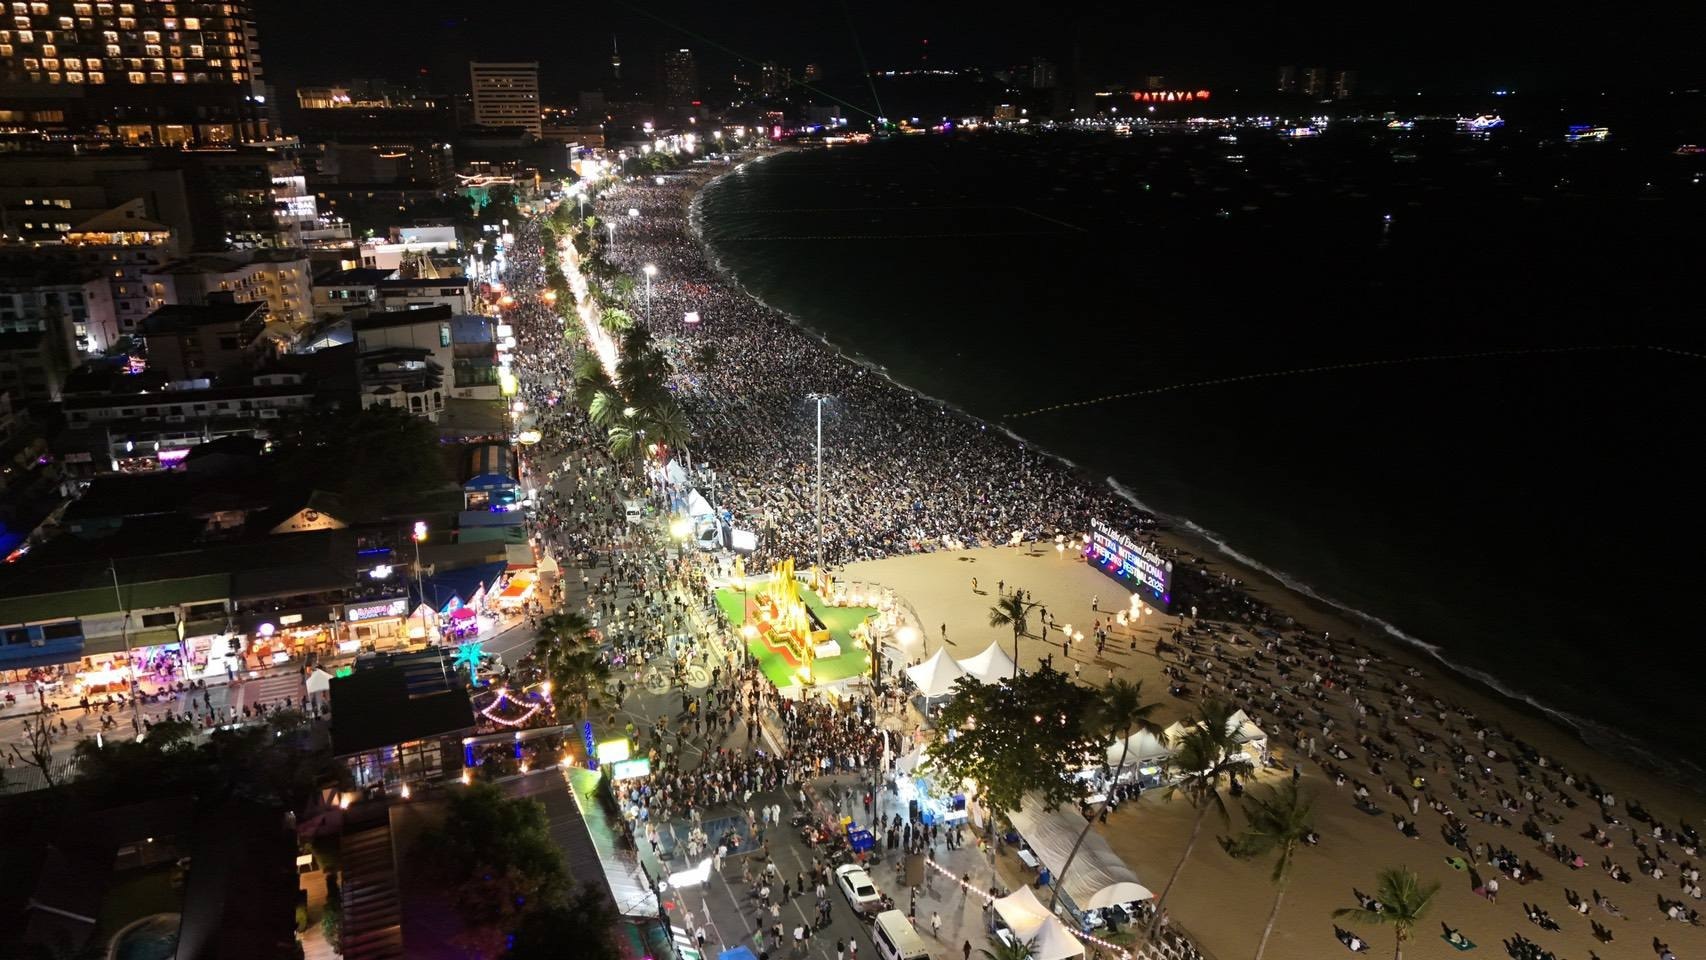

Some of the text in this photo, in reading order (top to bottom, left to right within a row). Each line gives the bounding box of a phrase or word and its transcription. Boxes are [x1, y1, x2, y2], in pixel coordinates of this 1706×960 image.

[1134, 91, 1193, 101] PATTAYA
[1118, 546, 1164, 582] INTERNATIONAL
[1123, 559, 1147, 584] FESTIVAL
[1146, 576, 1164, 593] 2025
